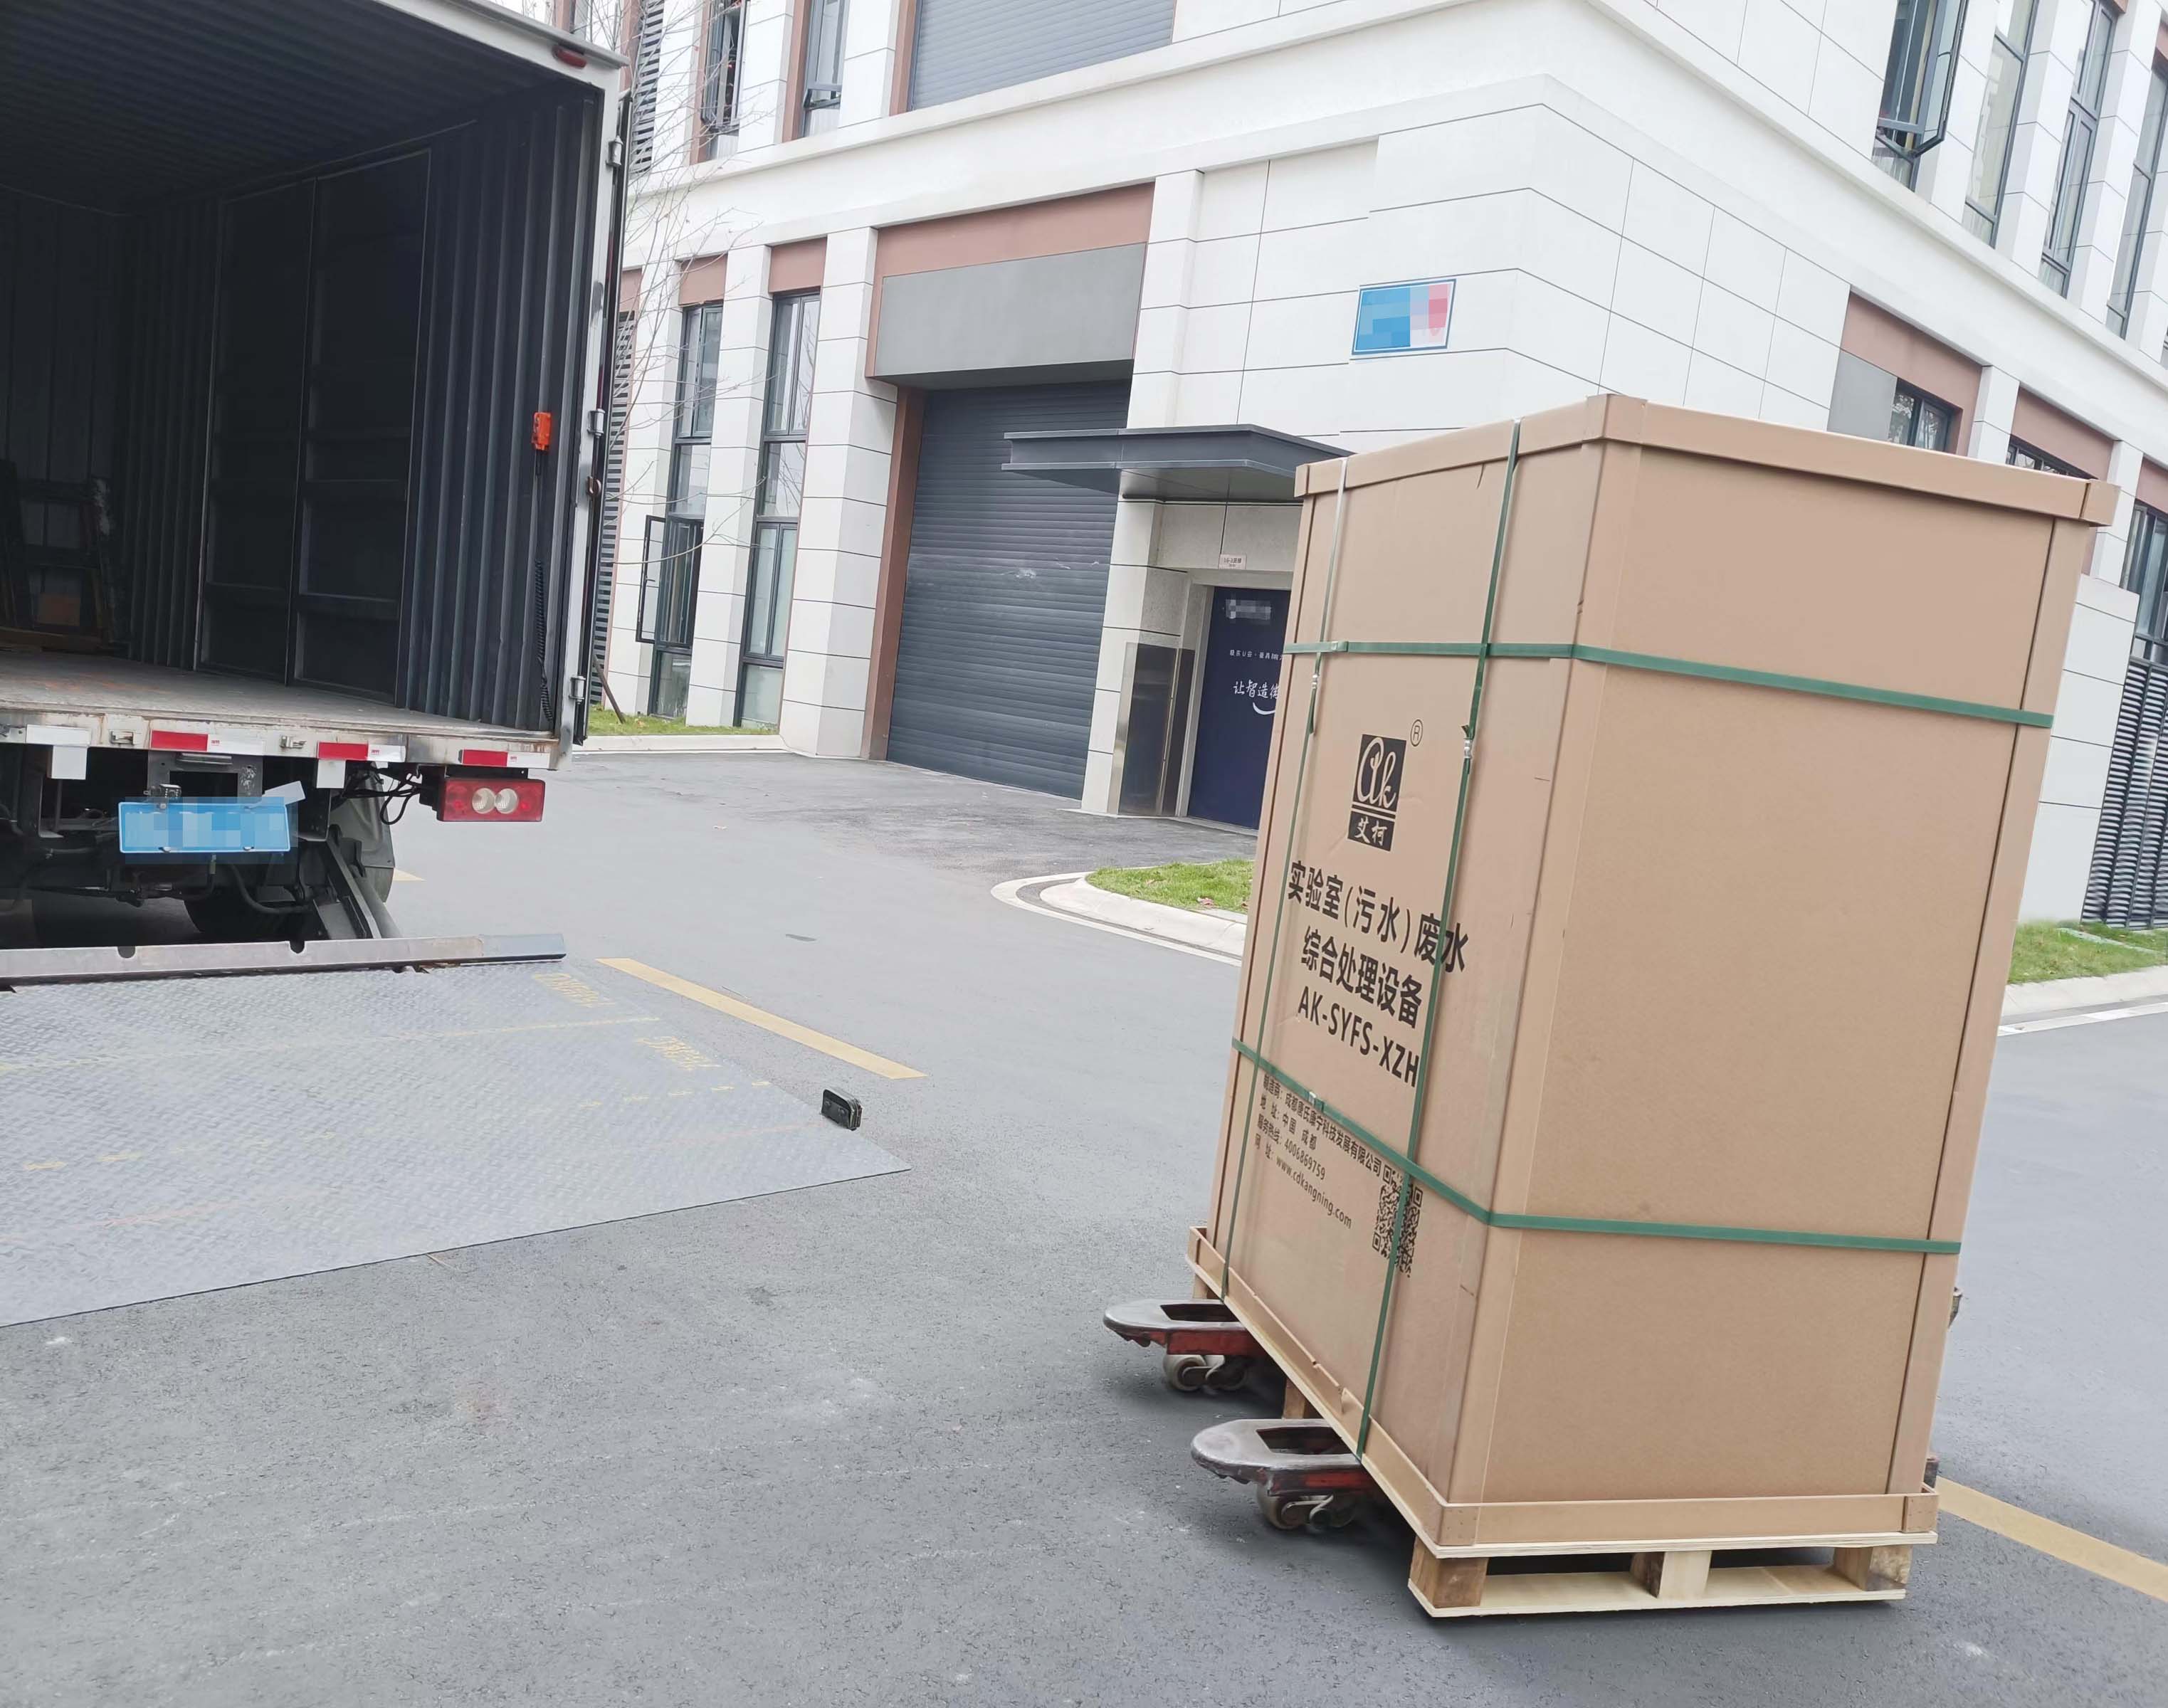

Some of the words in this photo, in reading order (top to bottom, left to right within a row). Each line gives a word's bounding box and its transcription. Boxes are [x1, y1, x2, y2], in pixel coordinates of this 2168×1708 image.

[1354, 816, 1387, 845] 艾柯
[1301, 925, 1422, 1029] 综合处理设备
[1298, 986, 1419, 1087] AK-SYFS-XZH
